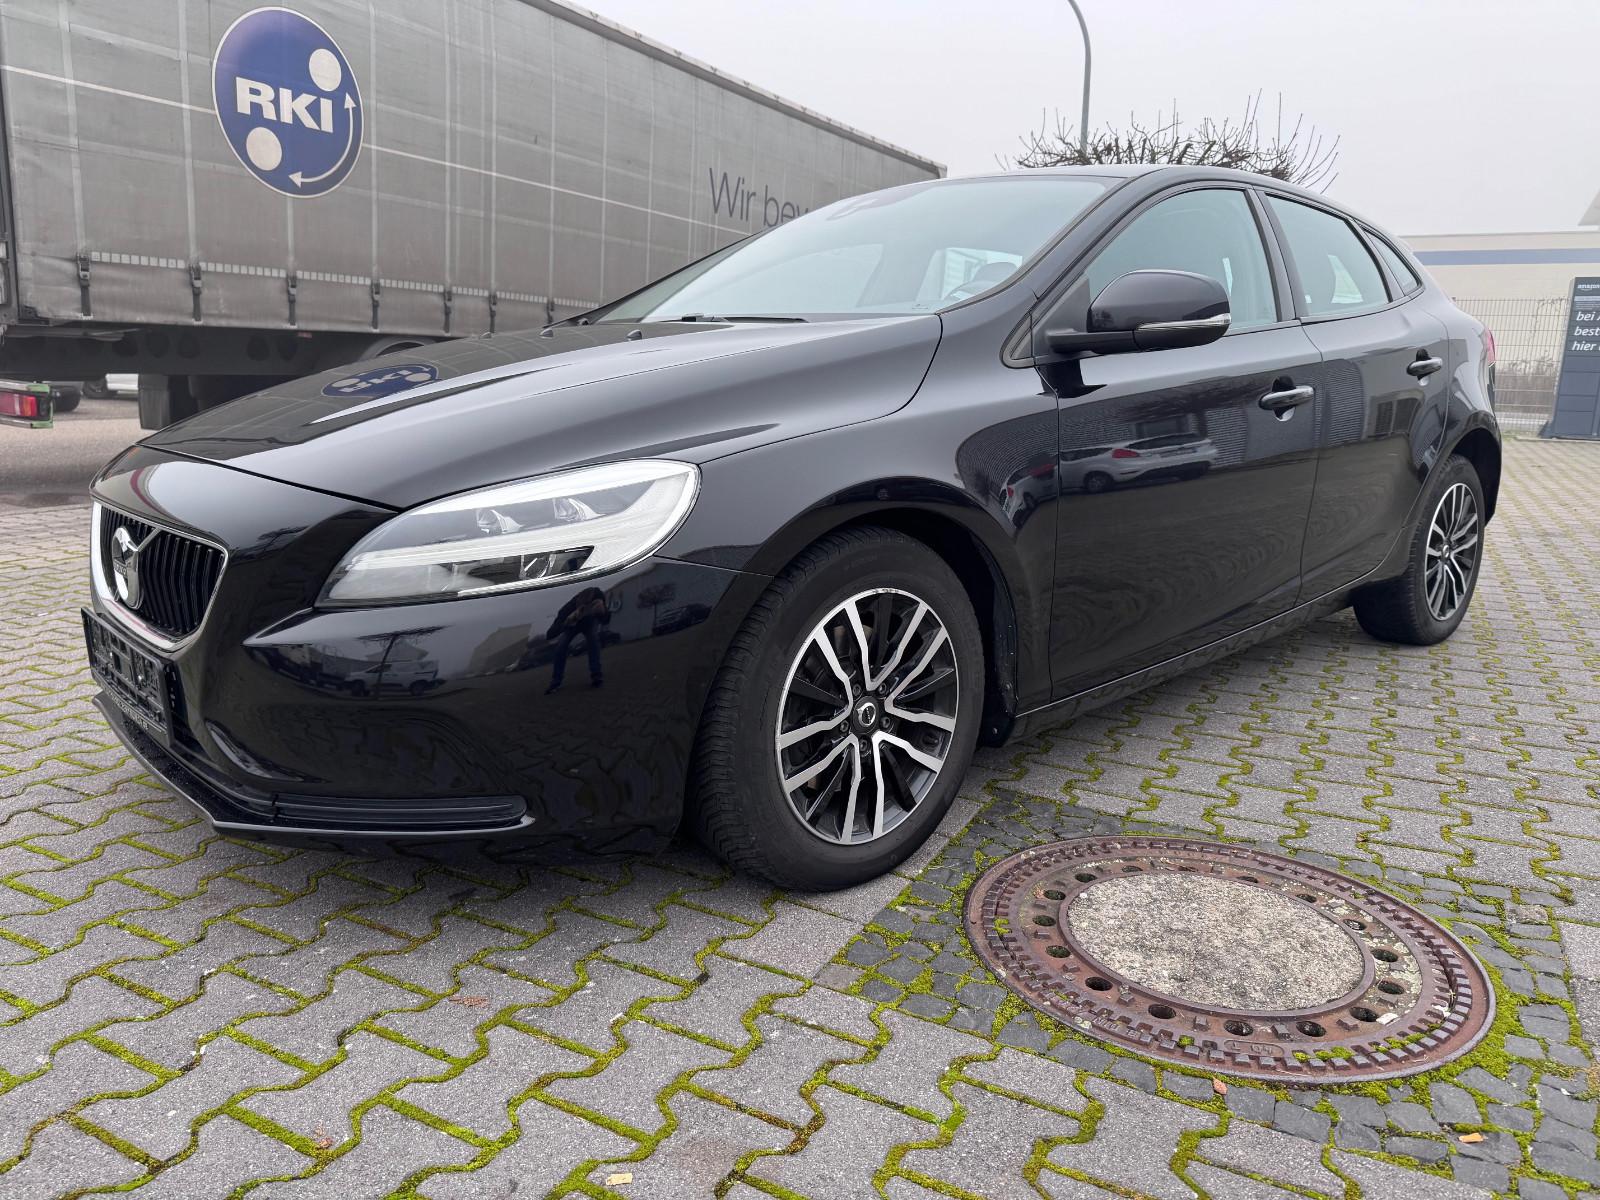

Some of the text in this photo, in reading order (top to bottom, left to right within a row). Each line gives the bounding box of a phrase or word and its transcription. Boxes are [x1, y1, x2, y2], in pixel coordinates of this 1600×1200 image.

[236, 76, 334, 133] RKI
[709, 167, 809, 228] Wir be
[1576, 311, 1596, 321] bei
[1571, 341, 1597, 351] hier
